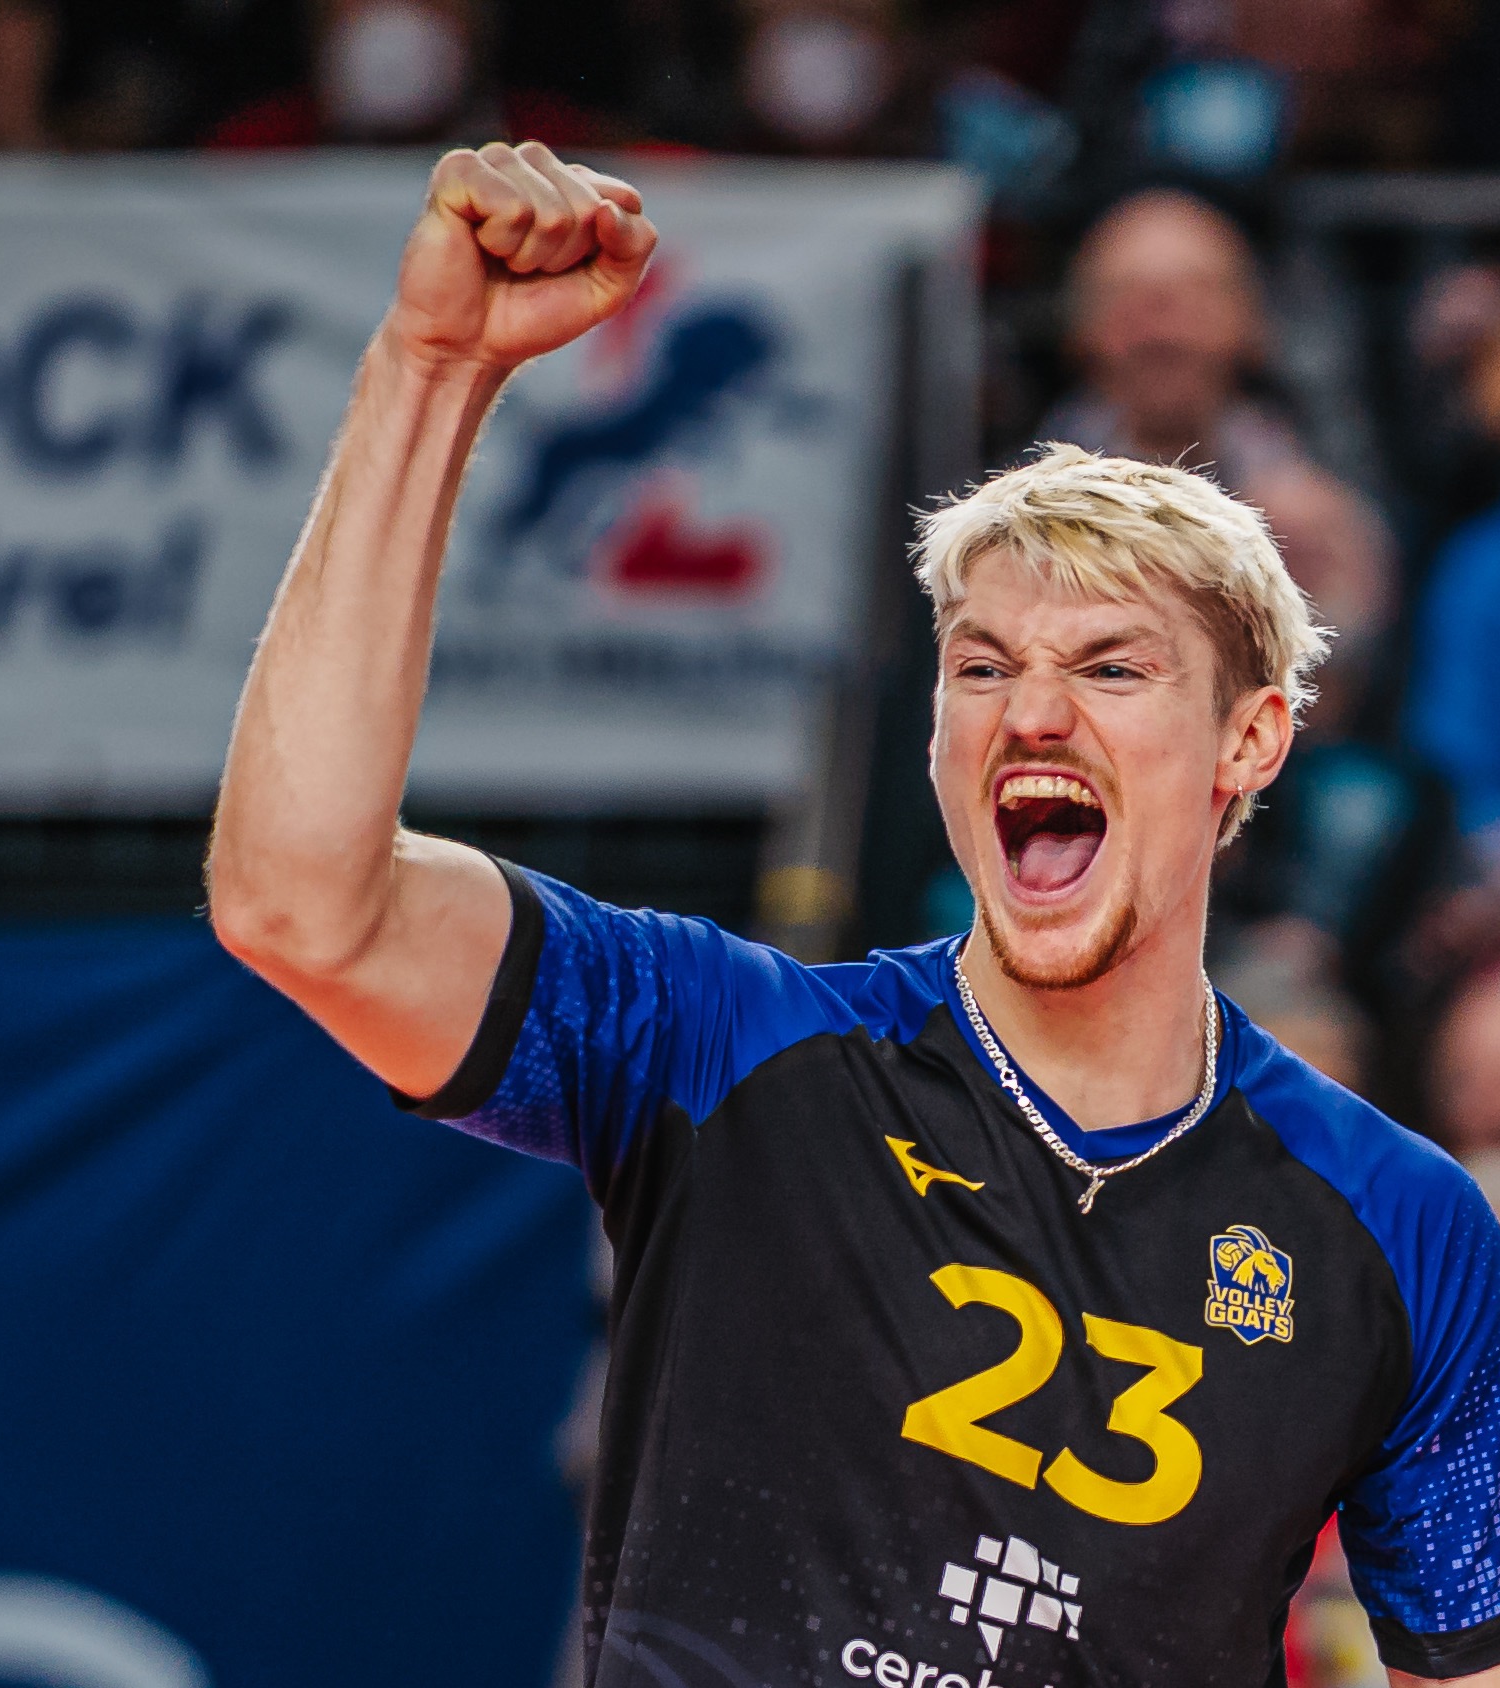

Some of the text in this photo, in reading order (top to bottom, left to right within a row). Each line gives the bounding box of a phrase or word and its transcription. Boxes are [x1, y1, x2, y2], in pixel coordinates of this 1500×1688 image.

[1214, 1284, 1289, 1316] VOLLEY
[1209, 1301, 1291, 1338] GOATS
[901, 1262, 1203, 1525] 23
